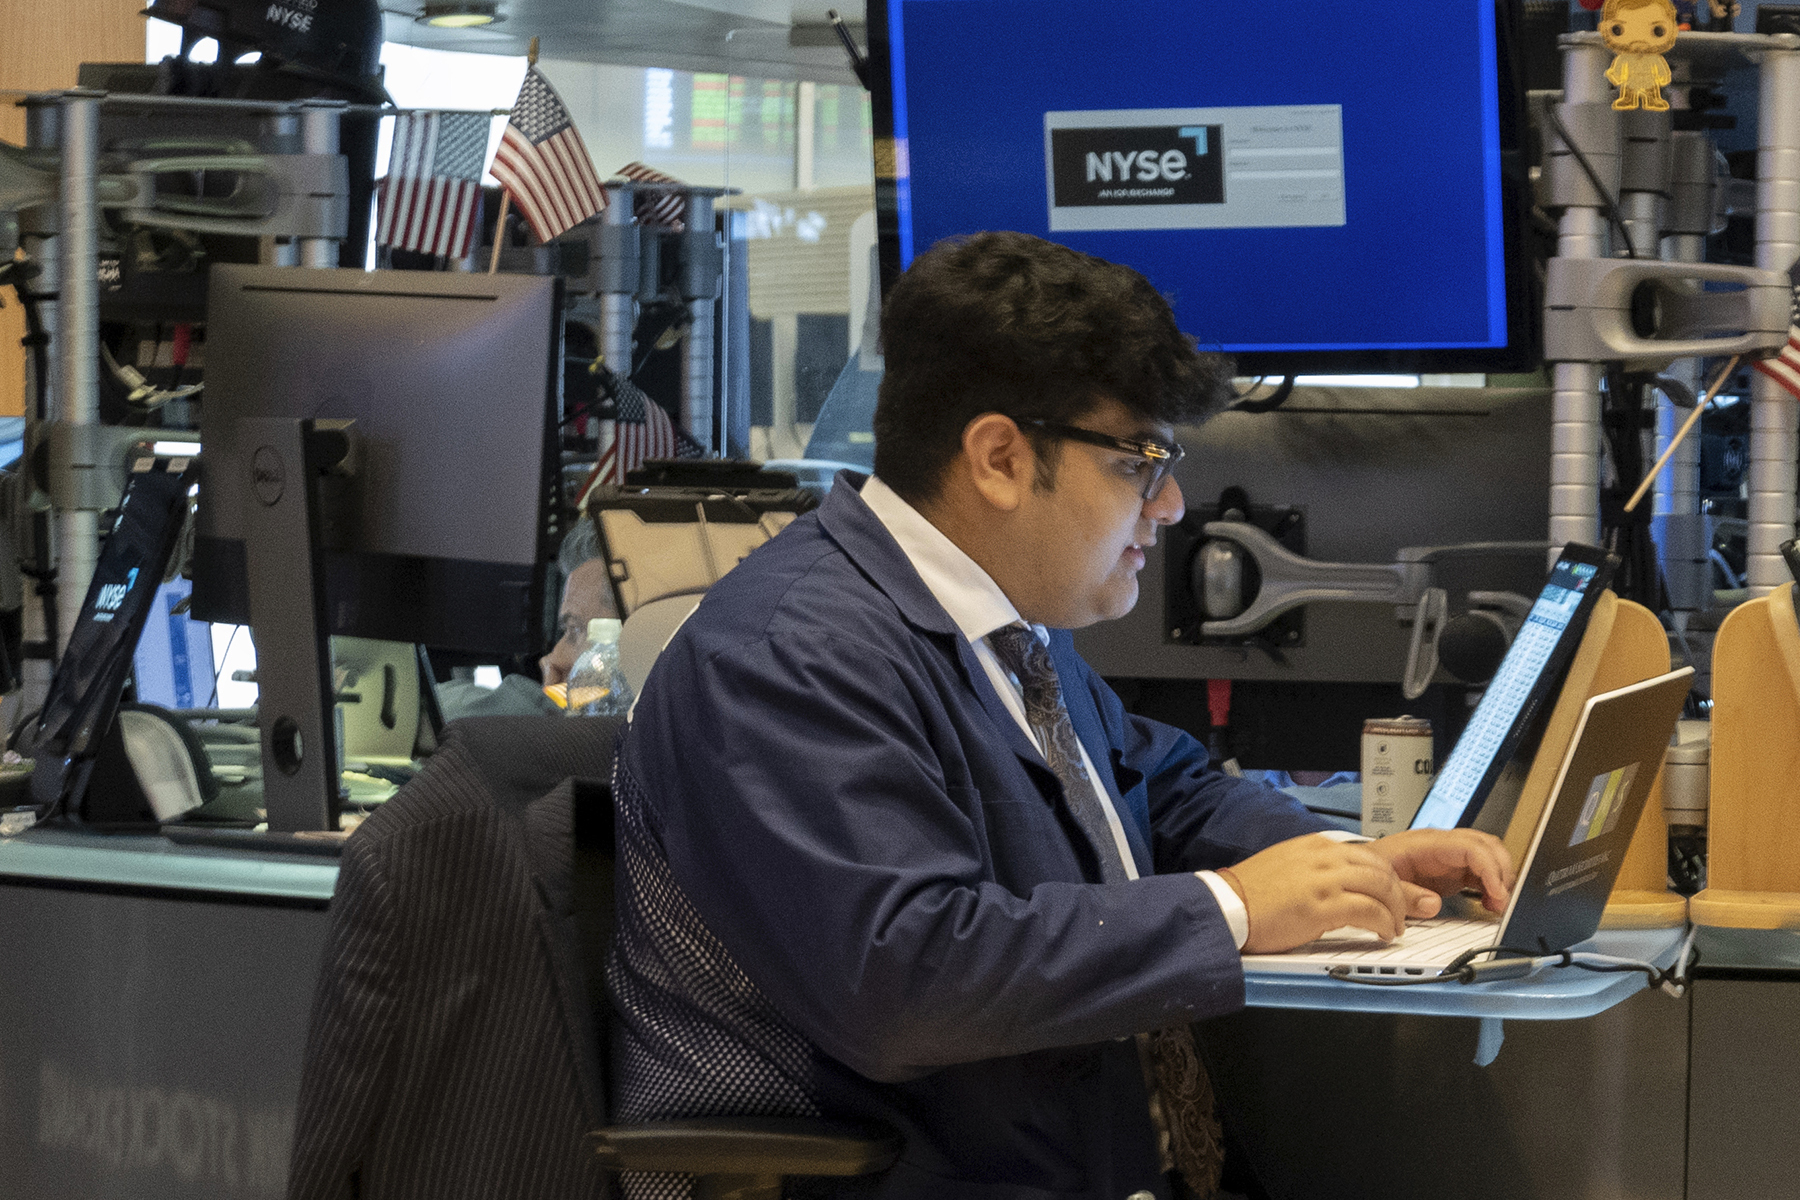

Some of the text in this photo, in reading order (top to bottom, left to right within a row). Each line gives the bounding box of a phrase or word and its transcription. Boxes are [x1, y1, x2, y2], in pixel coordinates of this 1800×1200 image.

[266, 4, 314, 33] NYSE
[1086, 149, 1188, 183] NYSE
[95, 583, 127, 611] NYSE
